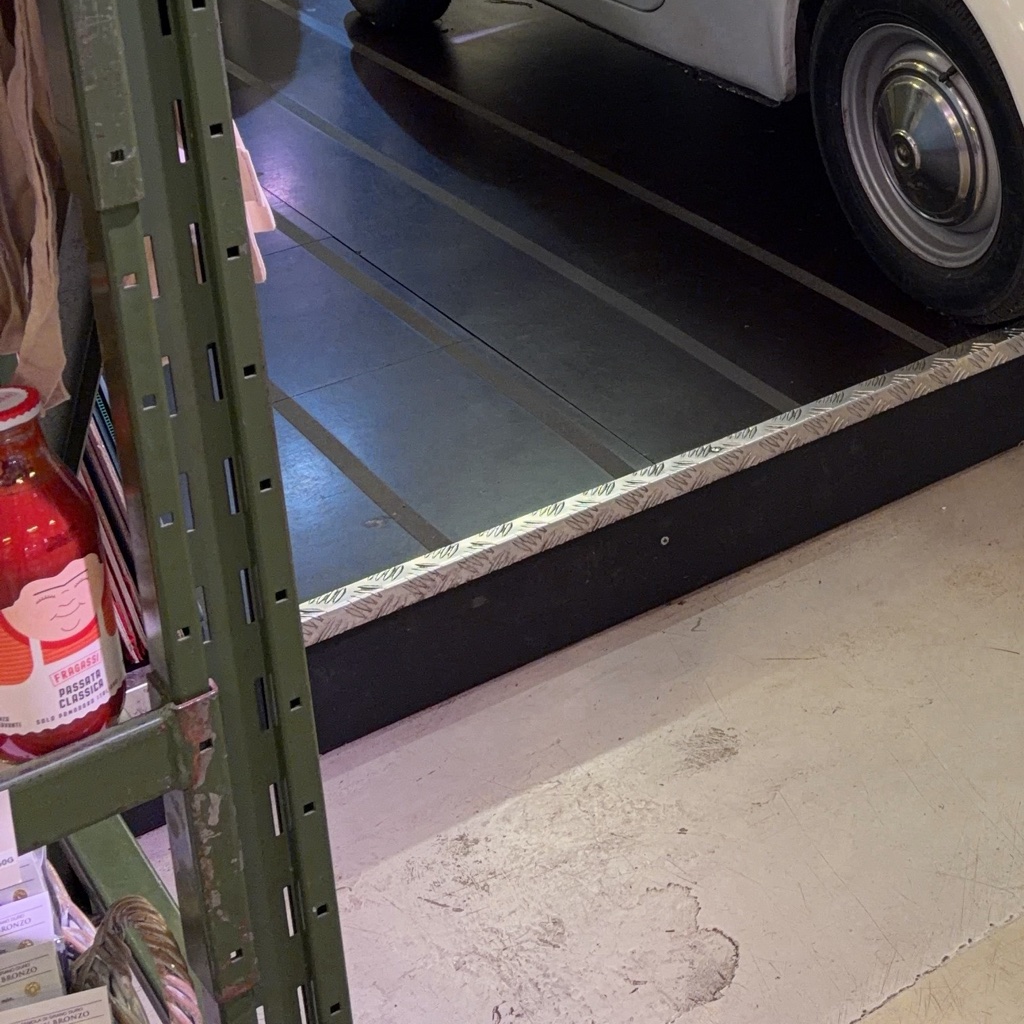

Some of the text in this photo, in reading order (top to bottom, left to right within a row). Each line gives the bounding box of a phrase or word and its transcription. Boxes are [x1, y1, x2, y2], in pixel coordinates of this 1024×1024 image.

[53, 653, 100, 683] FRAGASSI
[58, 669, 101, 698] PASSATA
[58, 678, 104, 709] CLASSICA
[36, 715, 55, 725] SOLO
[0, 917, 32, 933] RONZO
[1, 965, 38, 983] BRONZO
[52, 1010, 90, 1024] BRONZO
